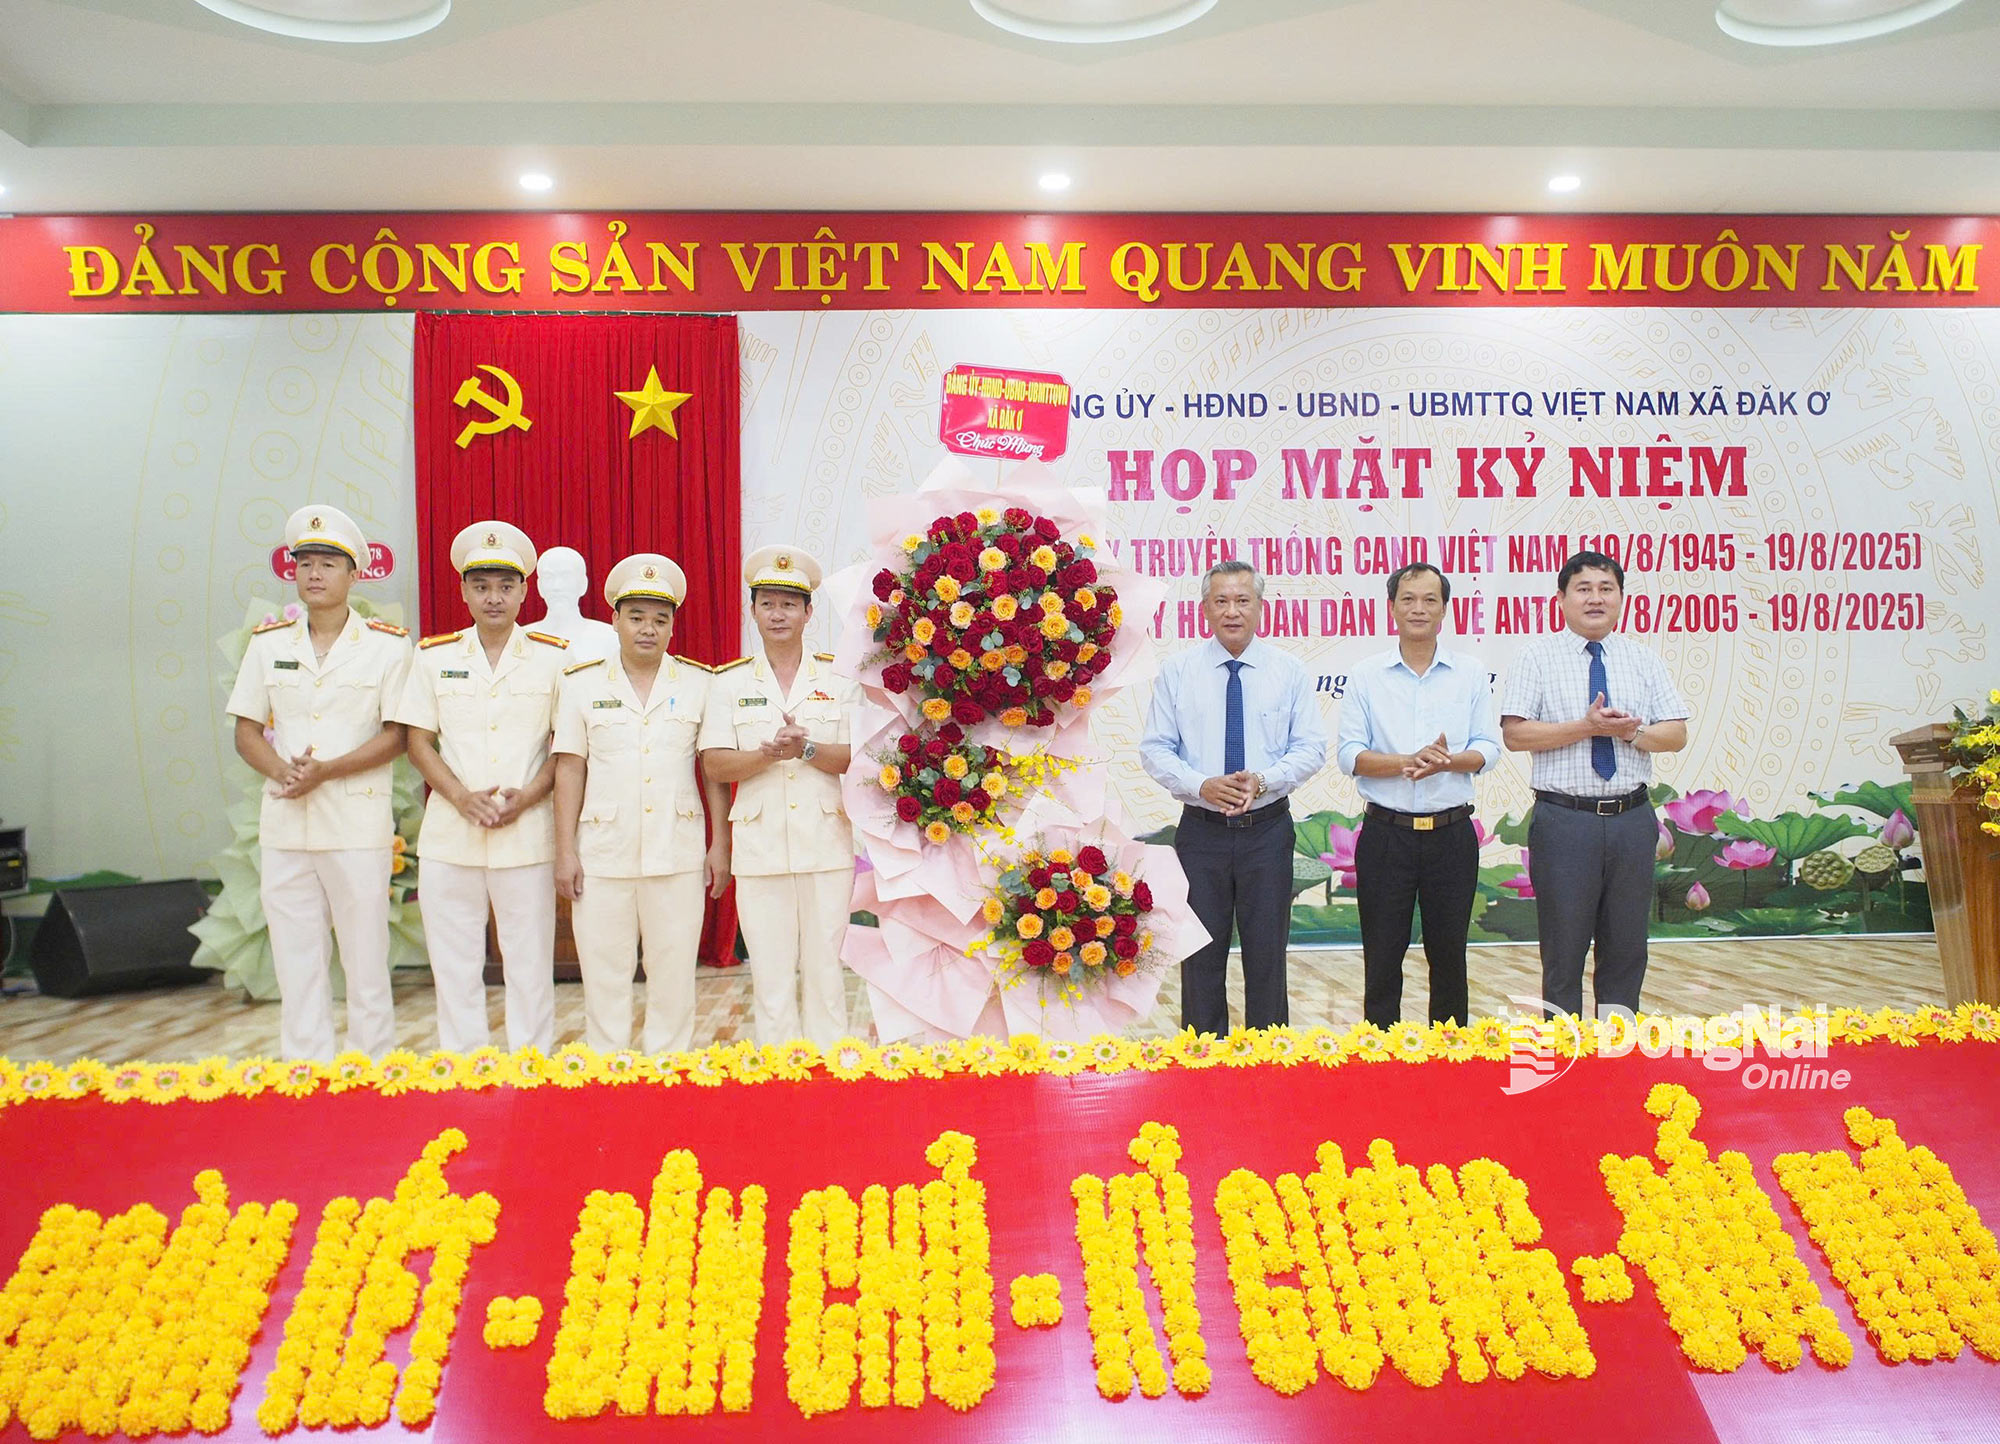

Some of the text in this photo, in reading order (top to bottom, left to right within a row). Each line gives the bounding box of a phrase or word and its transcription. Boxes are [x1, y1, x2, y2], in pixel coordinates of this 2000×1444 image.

[63, 221, 1984, 306] ĐẢNG CỘNG SẢN VIỆT NAM QUANG VINH MUÔN NĂM
[1071, 394, 1105, 419] NG
[1116, 388, 1156, 419] ỦY
[1184, 393, 1268, 418] HĐND
[1297, 392, 1380, 417] UBND
[1409, 391, 1533, 418] UBMTTQ
[1542, 387, 1606, 421] VIỆT
[1616, 391, 1679, 416] NAM
[1690, 386, 1728, 416] XÃ
[1736, 385, 1798, 416] ĐĂK
[1807, 391, 1831, 416] Ơ
[1107, 432, 1748, 514] HỌP MẶT KỶ NIỆM
[1131, 524, 1237, 577] TRUYỀN
[1248, 524, 1343, 576] THỐNG
[1354, 536, 1428, 575] CAND
[1438, 528, 1498, 581] VIỆT
[1509, 535, 1568, 573] NAM
[1765, 532, 1922, 572] 19/8/2025)
[1254, 594, 1309, 638] OÀN
[1320, 591, 1376, 637] DÂN
[1452, 590, 1485, 642] VỆ
[1612, 592, 1738, 634] /8/2005
[1767, 592, 1925, 632] 19/8/2025)
